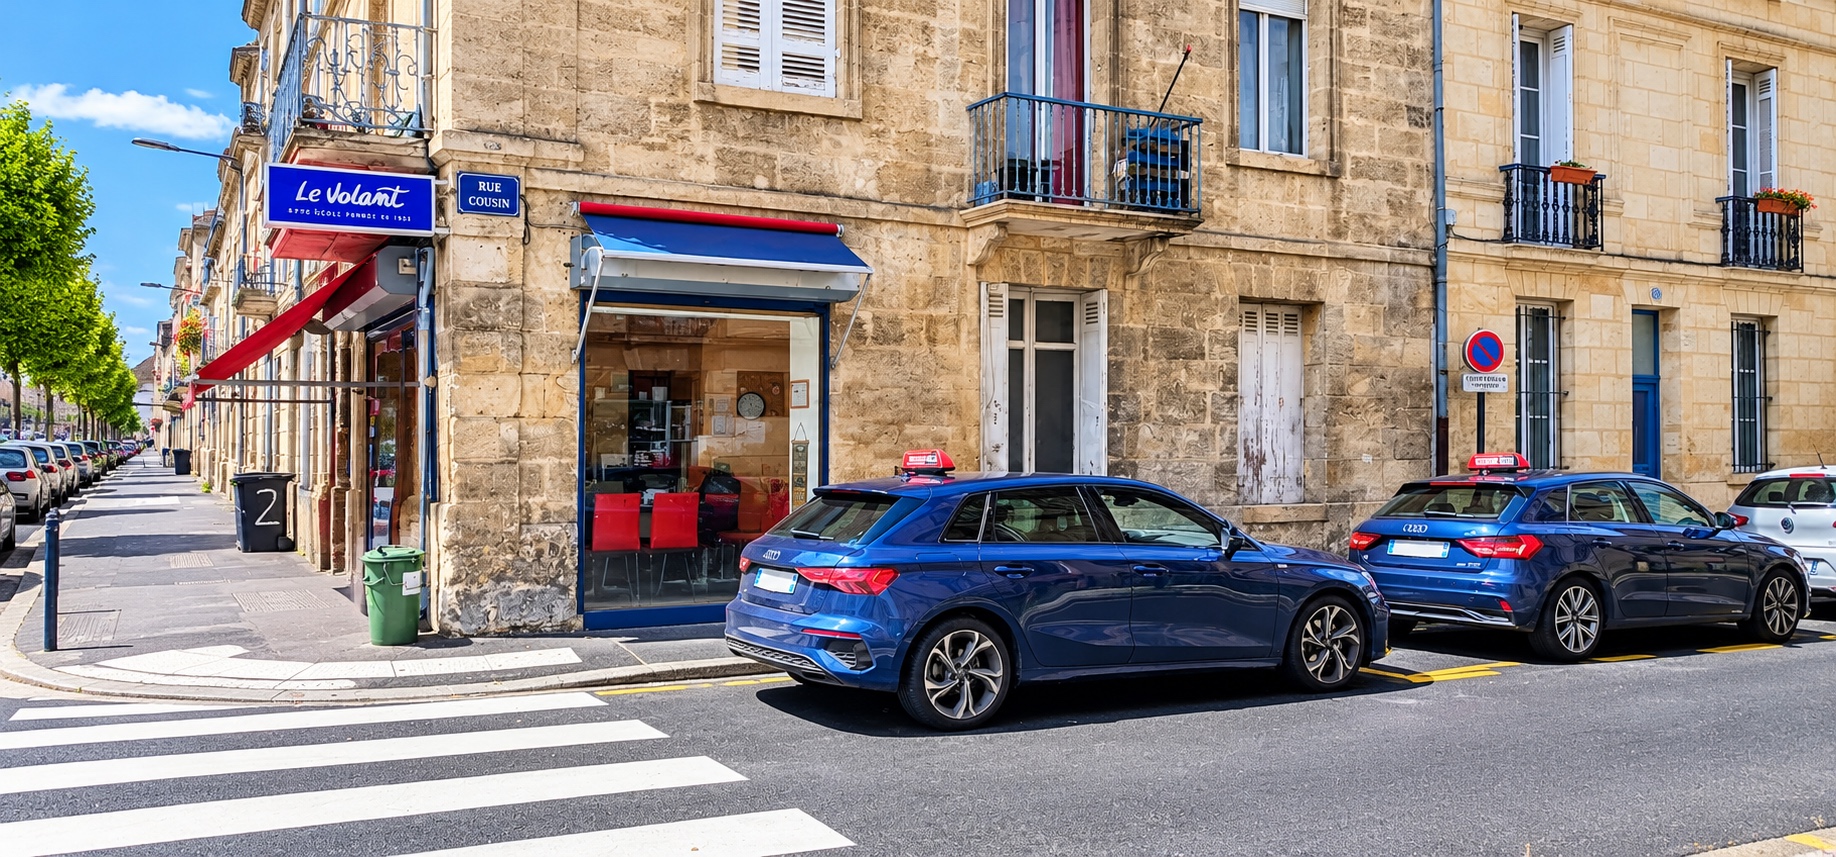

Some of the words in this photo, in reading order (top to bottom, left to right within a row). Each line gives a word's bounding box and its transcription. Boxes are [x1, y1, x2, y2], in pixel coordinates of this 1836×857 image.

[295, 180, 321, 203] Le
[326, 182, 410, 209] Volant
[478, 181, 502, 193] RUE
[468, 196, 510, 209] COUSIN
[254, 488, 281, 526] 2
